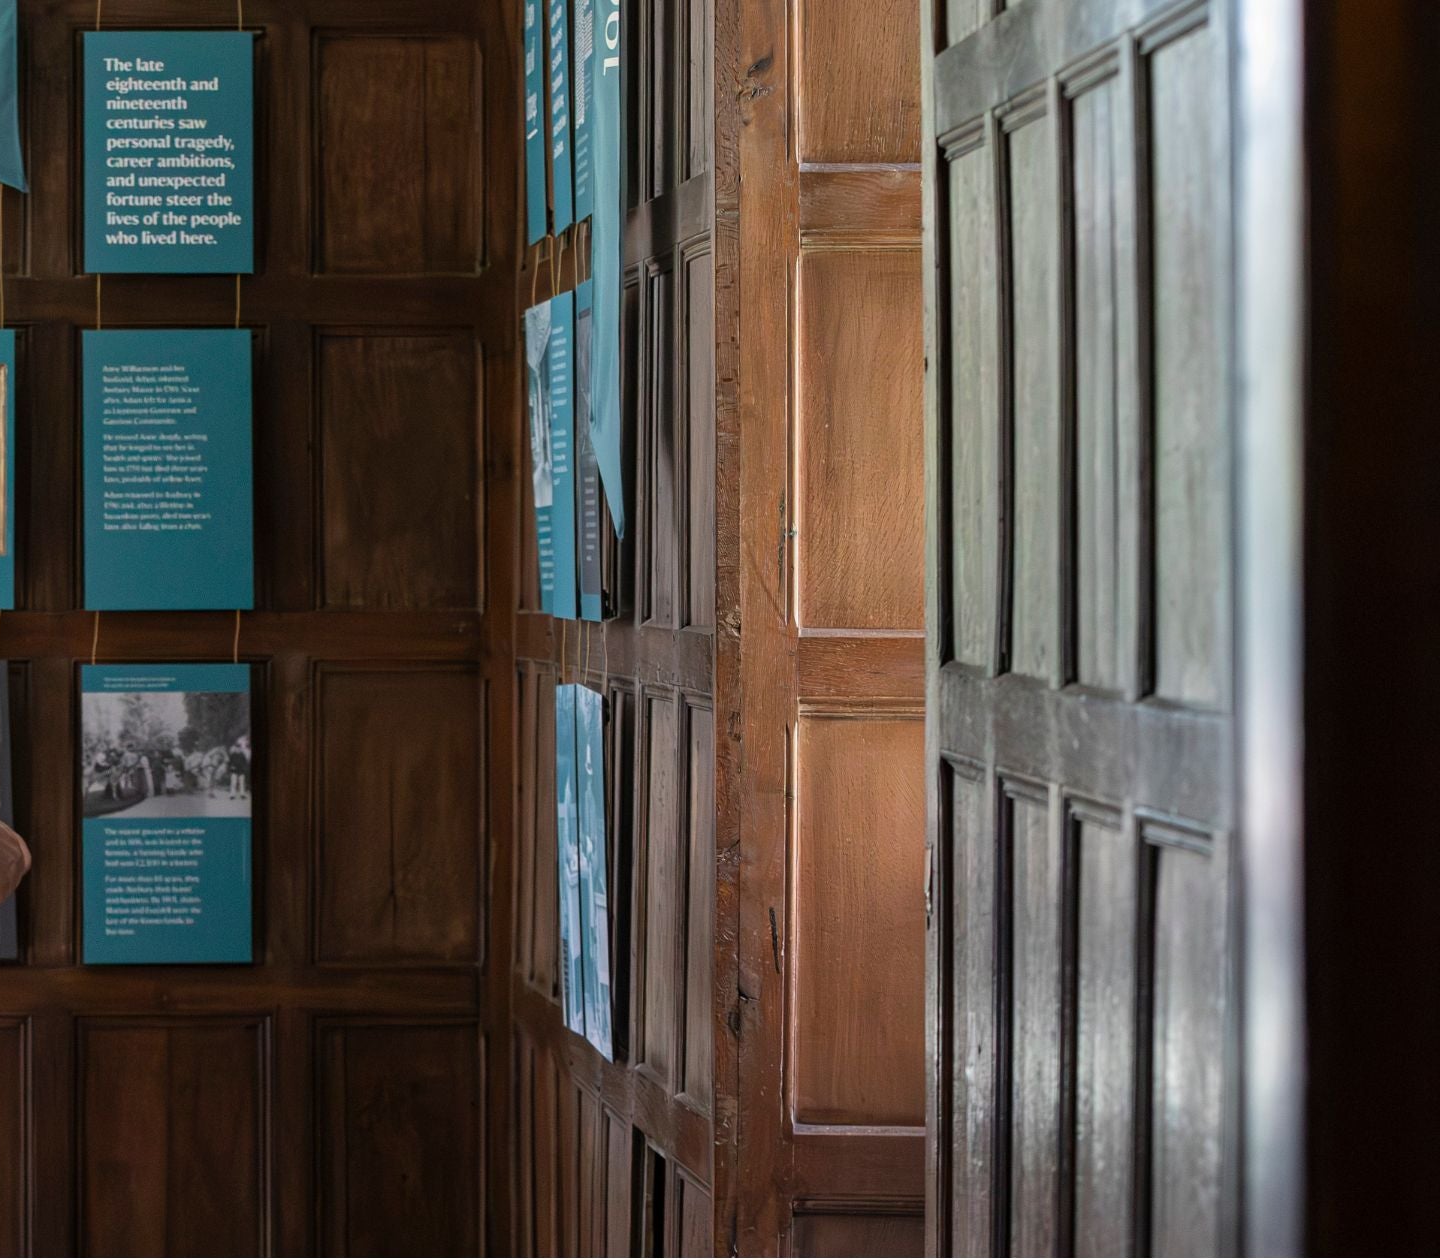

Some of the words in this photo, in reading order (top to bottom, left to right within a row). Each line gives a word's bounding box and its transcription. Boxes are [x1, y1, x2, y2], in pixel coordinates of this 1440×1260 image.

[103, 57, 133, 72] The
[136, 57, 164, 72] late
[106, 77, 187, 94] eighteenth
[190, 77, 219, 91] and
[106, 96, 187, 110] nineteenth
[106, 116, 175, 129] centuries
[178, 119, 207, 129] saw
[106, 134, 171, 152] personal
[174, 134, 235, 152] tragedy,
[106, 157, 154, 168] career
[157, 154, 235, 170] ambitions,
[106, 173, 135, 187] and
[138, 173, 226, 190] unexpected
[106, 192, 163, 206] fortune
[166, 194, 203, 206] steer
[207, 192, 232, 206] the
[106, 211, 140, 226] lives
[143, 211, 160, 225] of
[162, 211, 188, 226] the
[190, 212, 241, 228] people
[105, 230, 138, 245] who
[141, 230, 177, 245] lived
[180, 230, 217, 245] here.
